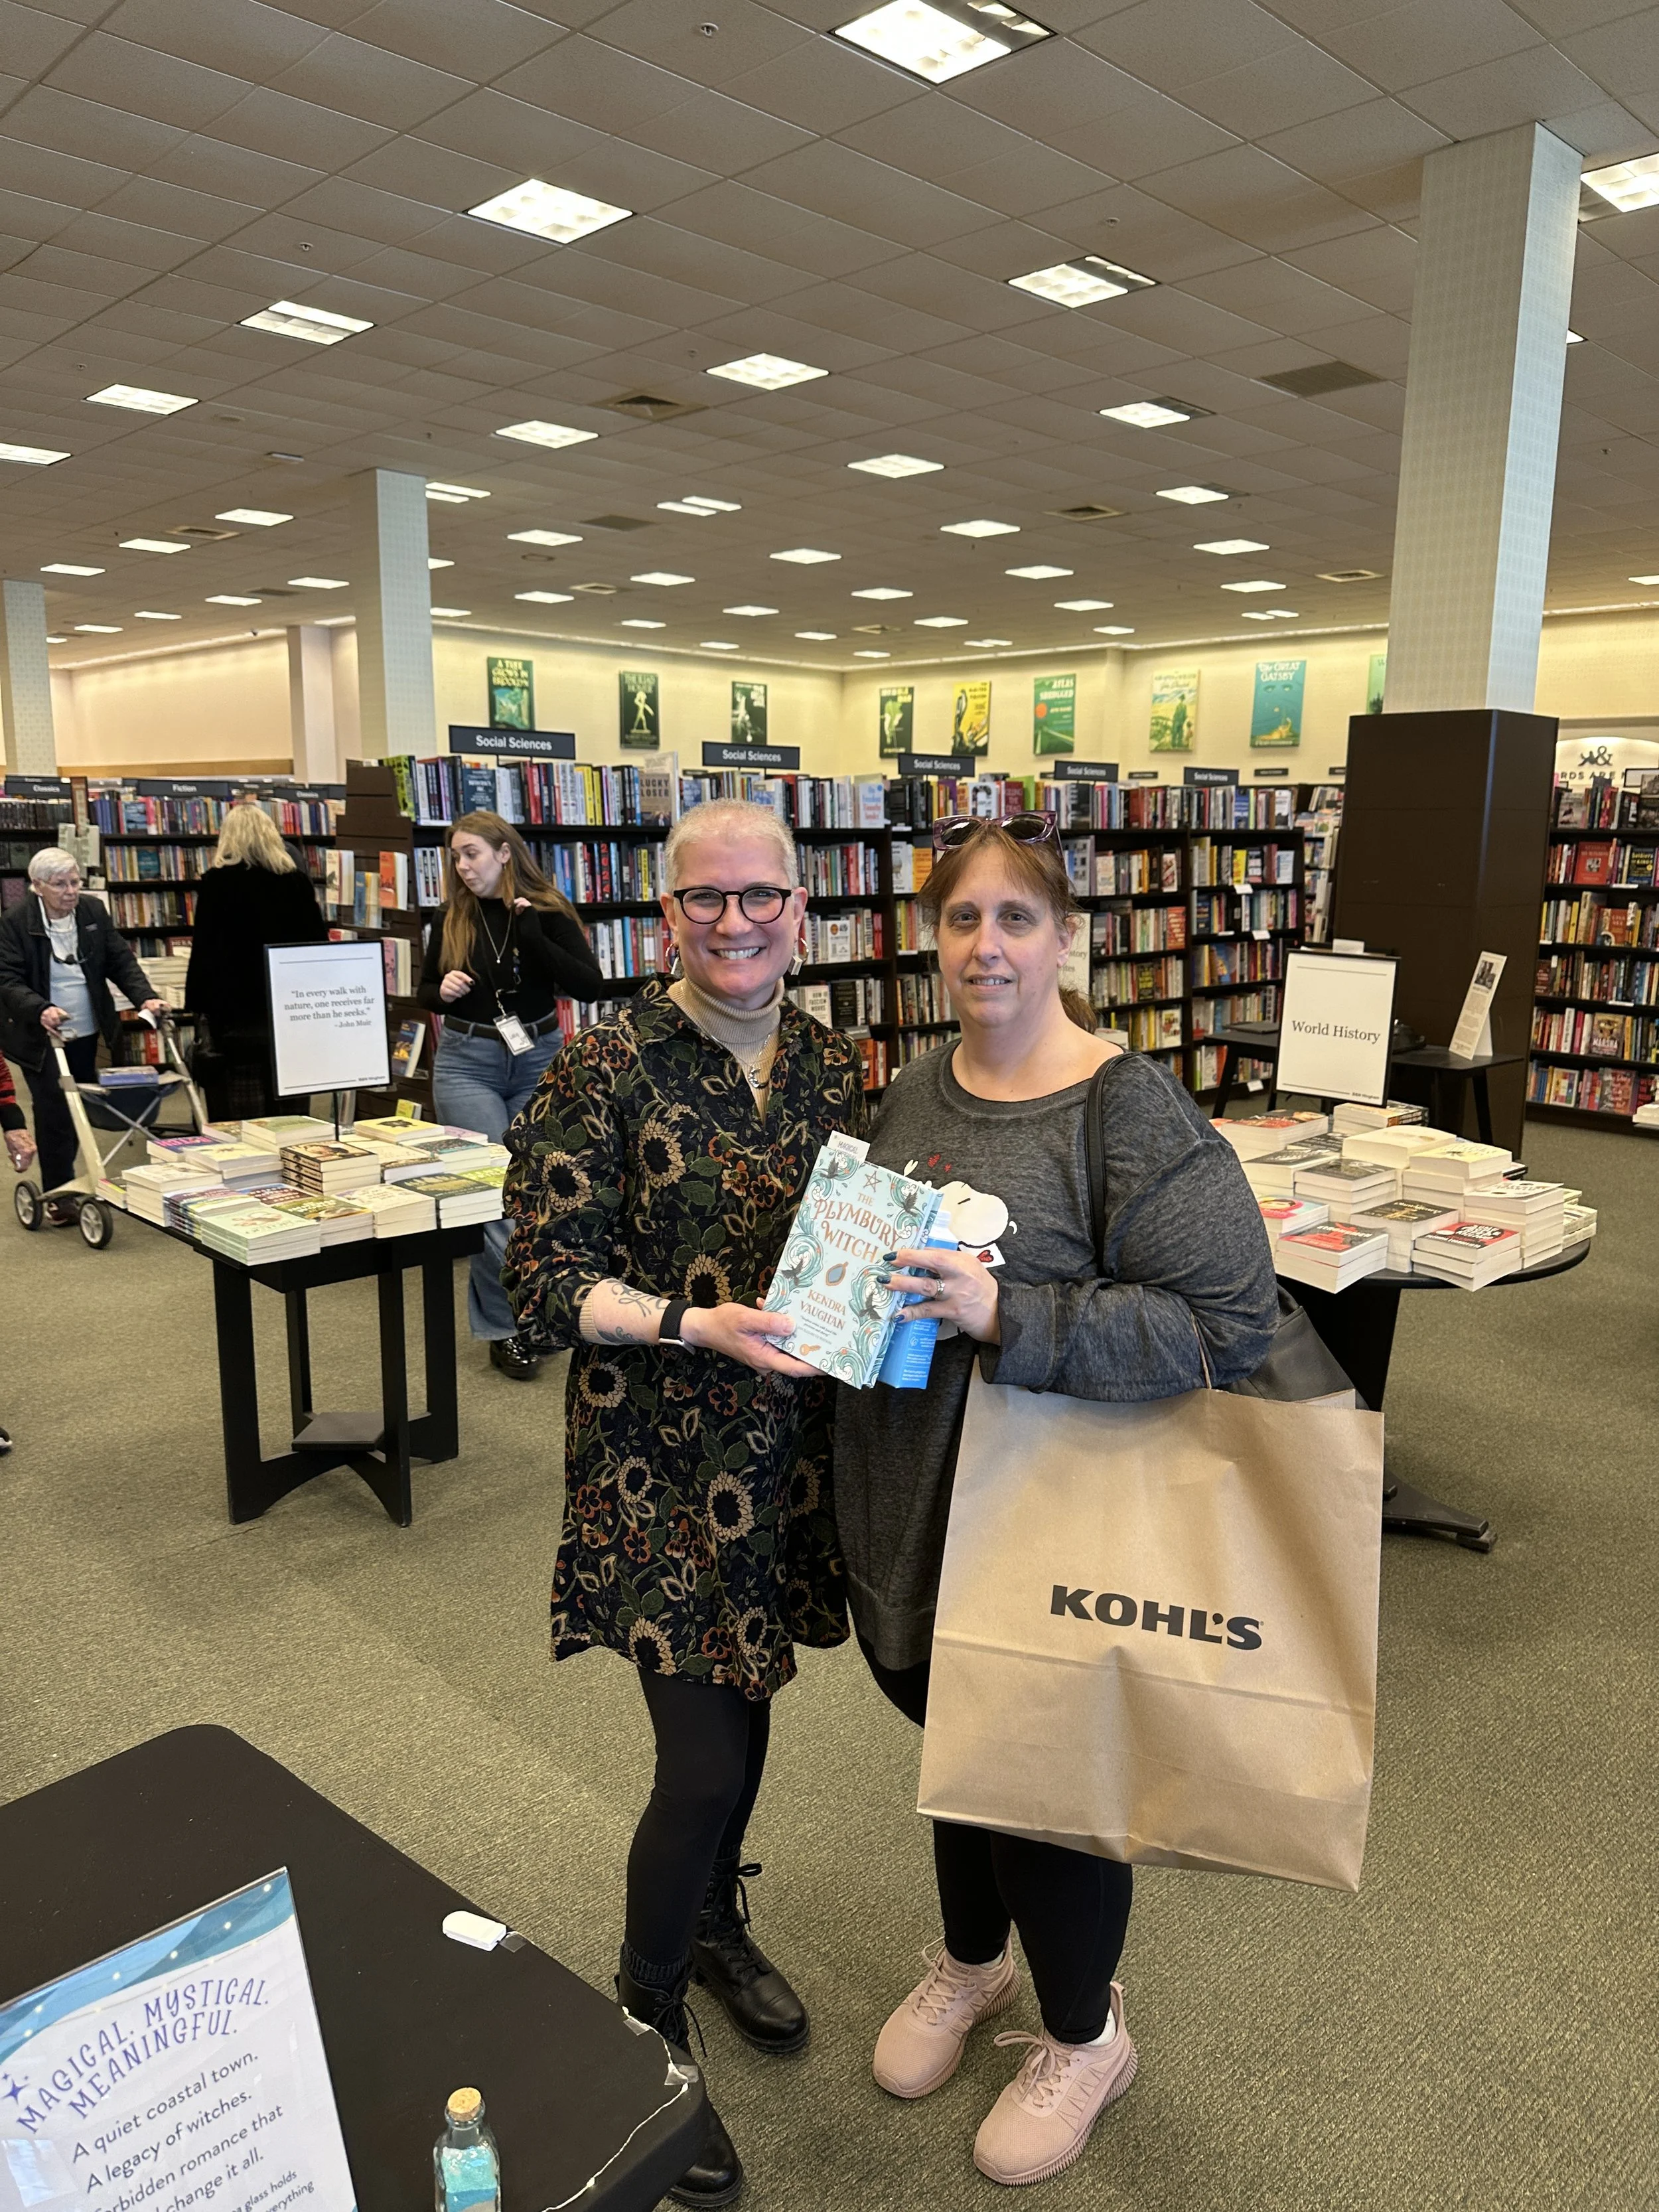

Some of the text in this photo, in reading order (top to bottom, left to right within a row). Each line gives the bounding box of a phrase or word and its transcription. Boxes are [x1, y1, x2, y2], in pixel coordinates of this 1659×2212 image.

[1260, 671, 1295, 682] GATSBY
[476, 735, 552, 751] Social Sciences
[722, 749, 782, 763] Social Sciences
[914, 759, 961, 771] Social Sciences
[1067, 766, 1106, 776] Social Sciences
[1561, 771, 1584, 780] RDS
[33, 784, 60, 793] Classics
[172, 784, 197, 792] Fiction
[640, 778, 669, 787] LUCKY
[640, 788, 669, 797] LOSER
[306, 989, 327, 998] every
[329, 986, 348, 995] walk
[349, 985, 366, 994] with
[284, 1001, 313, 1011] nature,
[331, 997, 362, 1007] receives
[313, 1010, 331, 1019] than
[332, 1009, 343, 1018] he
[1292, 1020, 1381, 1044] World History
[857, 1192, 874, 1207] THE
[813, 1199, 901, 1251] PLYMBURY
[821, 1220, 879, 1264] WITCH
[807, 1289, 847, 1316] KENDRA
[800, 1300, 847, 1331] VAUGHAN
[1050, 1584, 1262, 1651] KOHL'S
[16, 1978, 269, 2134] MAGICAL. MYSTICAL.
[68, 2010, 237, 2119] MEANINGFUL.
[73, 2051, 258, 2163] A quiet coastal town.
[87, 2091, 252, 2193] A legacy of witches.
[180, 2128, 248, 2176] romance
[252, 2104, 283, 2132] that
[167, 2147, 264, 2212] change it all.
[244, 2170, 297, 2212] glass holds
[266, 2181, 315, 2212] verything
